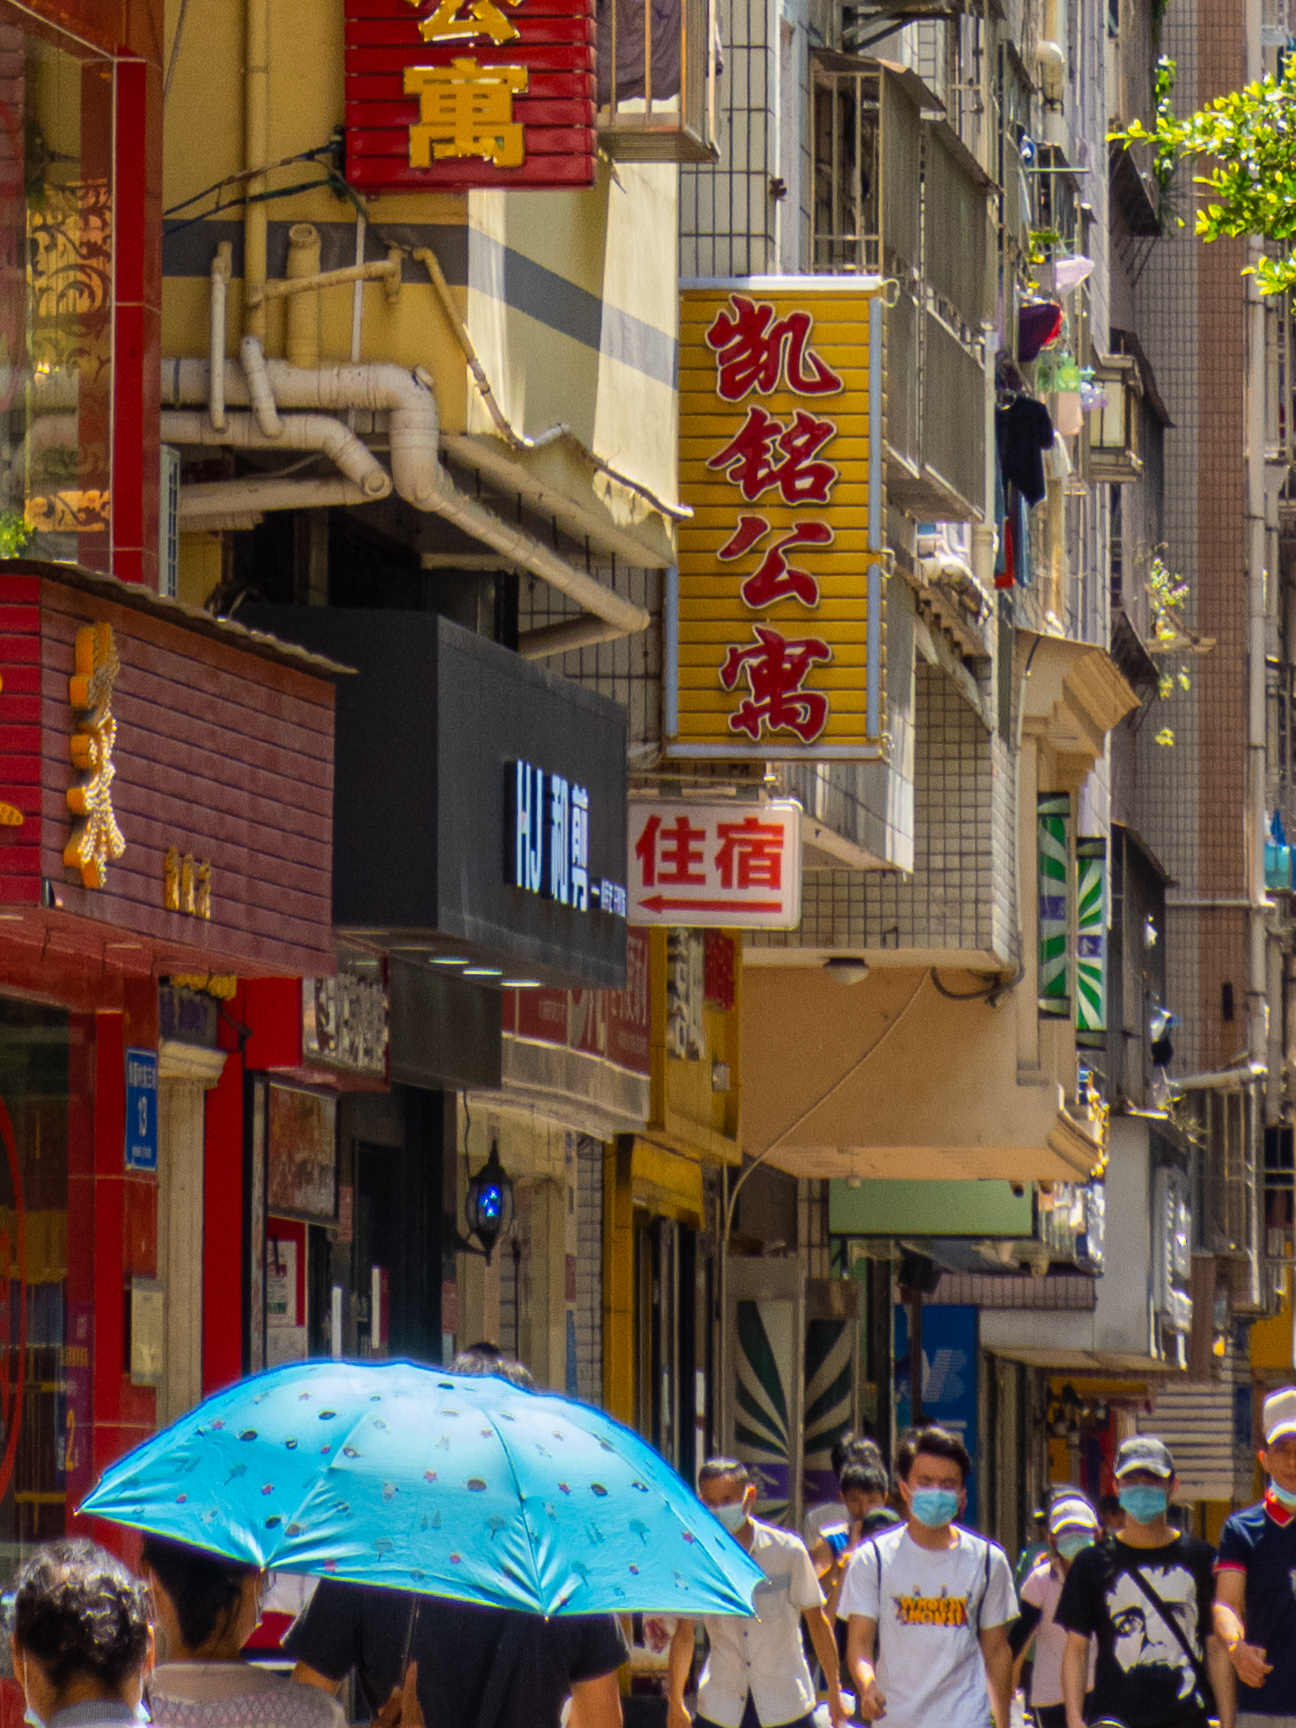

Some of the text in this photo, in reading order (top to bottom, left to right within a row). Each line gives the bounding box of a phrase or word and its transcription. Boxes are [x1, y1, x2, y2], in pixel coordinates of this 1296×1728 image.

[706, 294, 842, 745] 凯铭公寓
[635, 814, 785, 891] 住宿
